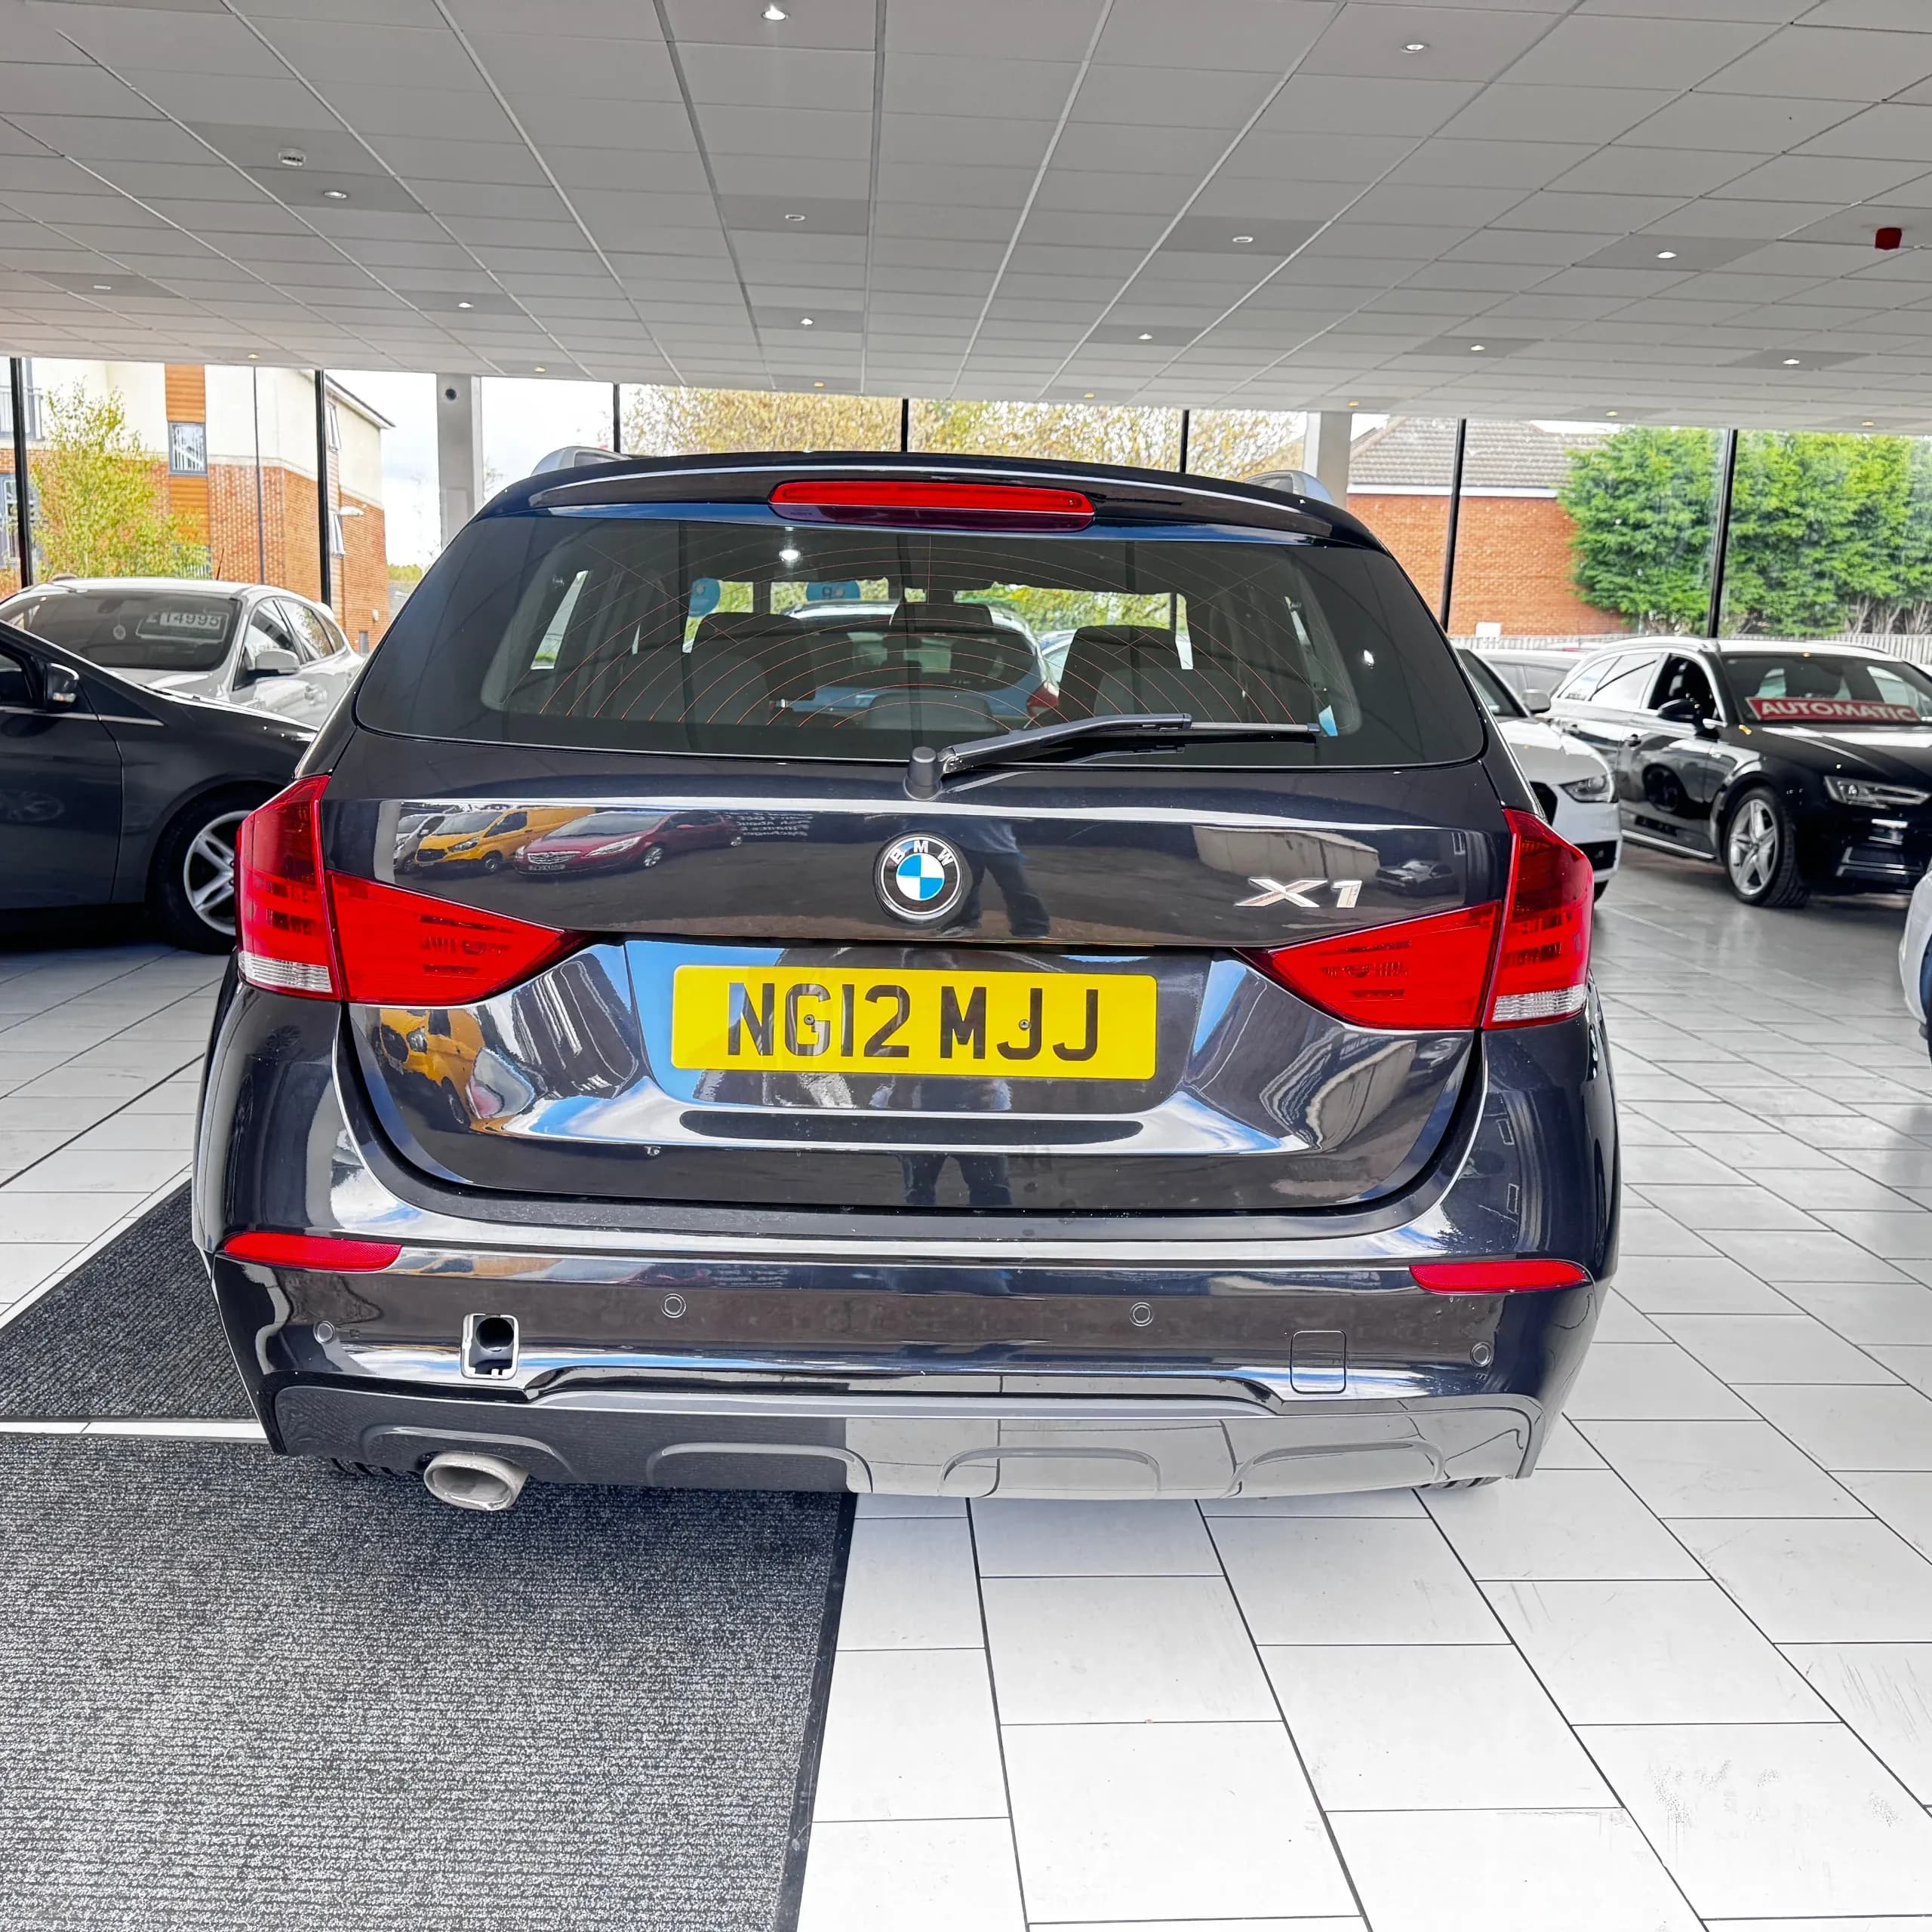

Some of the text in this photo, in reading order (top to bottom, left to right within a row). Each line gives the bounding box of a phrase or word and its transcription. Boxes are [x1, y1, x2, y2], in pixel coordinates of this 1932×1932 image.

[1761, 700, 1918, 721] AUTOMATIC
[889, 839, 954, 866] BMW
[1234, 878, 1363, 909] X1
[728, 982, 1099, 1061] NG12 MJJ
